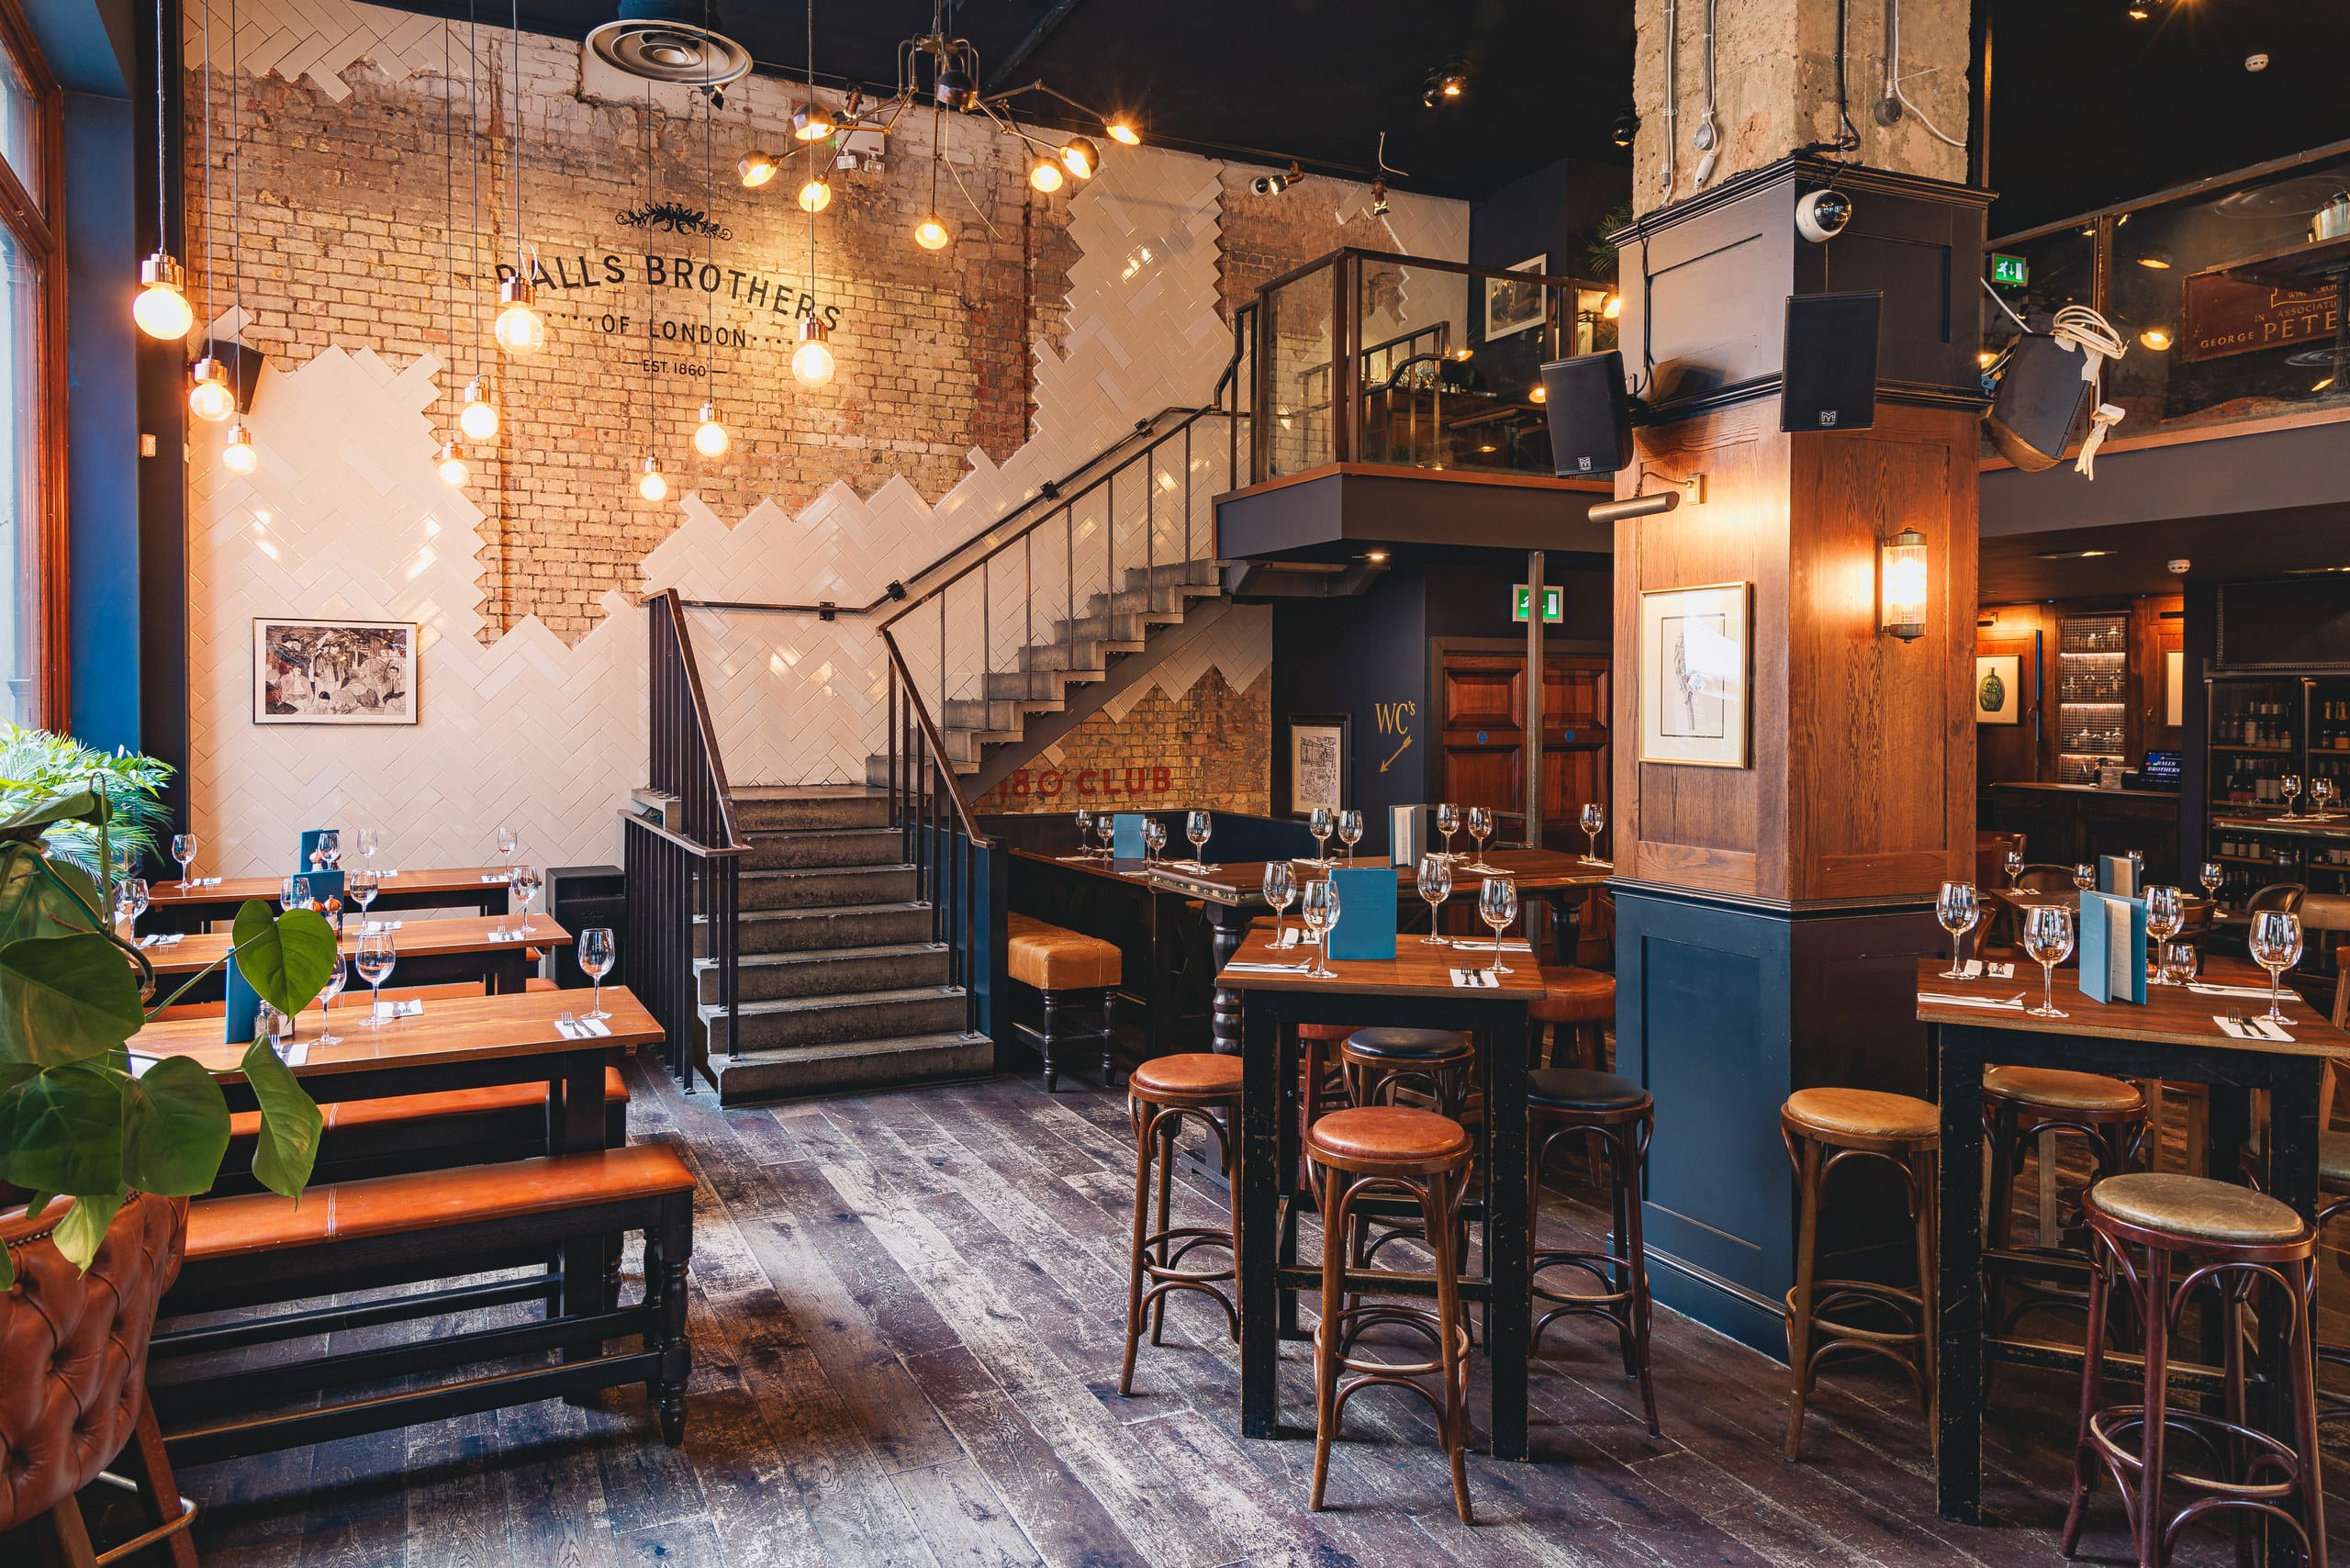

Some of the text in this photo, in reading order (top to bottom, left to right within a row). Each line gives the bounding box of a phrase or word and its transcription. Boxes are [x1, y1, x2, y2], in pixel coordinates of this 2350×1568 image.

[646, 255, 841, 331] BROTHERS
[601, 313, 746, 347] OF LONDON
[2200, 331, 2254, 349] GEORGE
[643, 359, 706, 376] EST. 1860
[1375, 700, 1416, 735] WC's
[1077, 767, 1171, 797] CLUB
